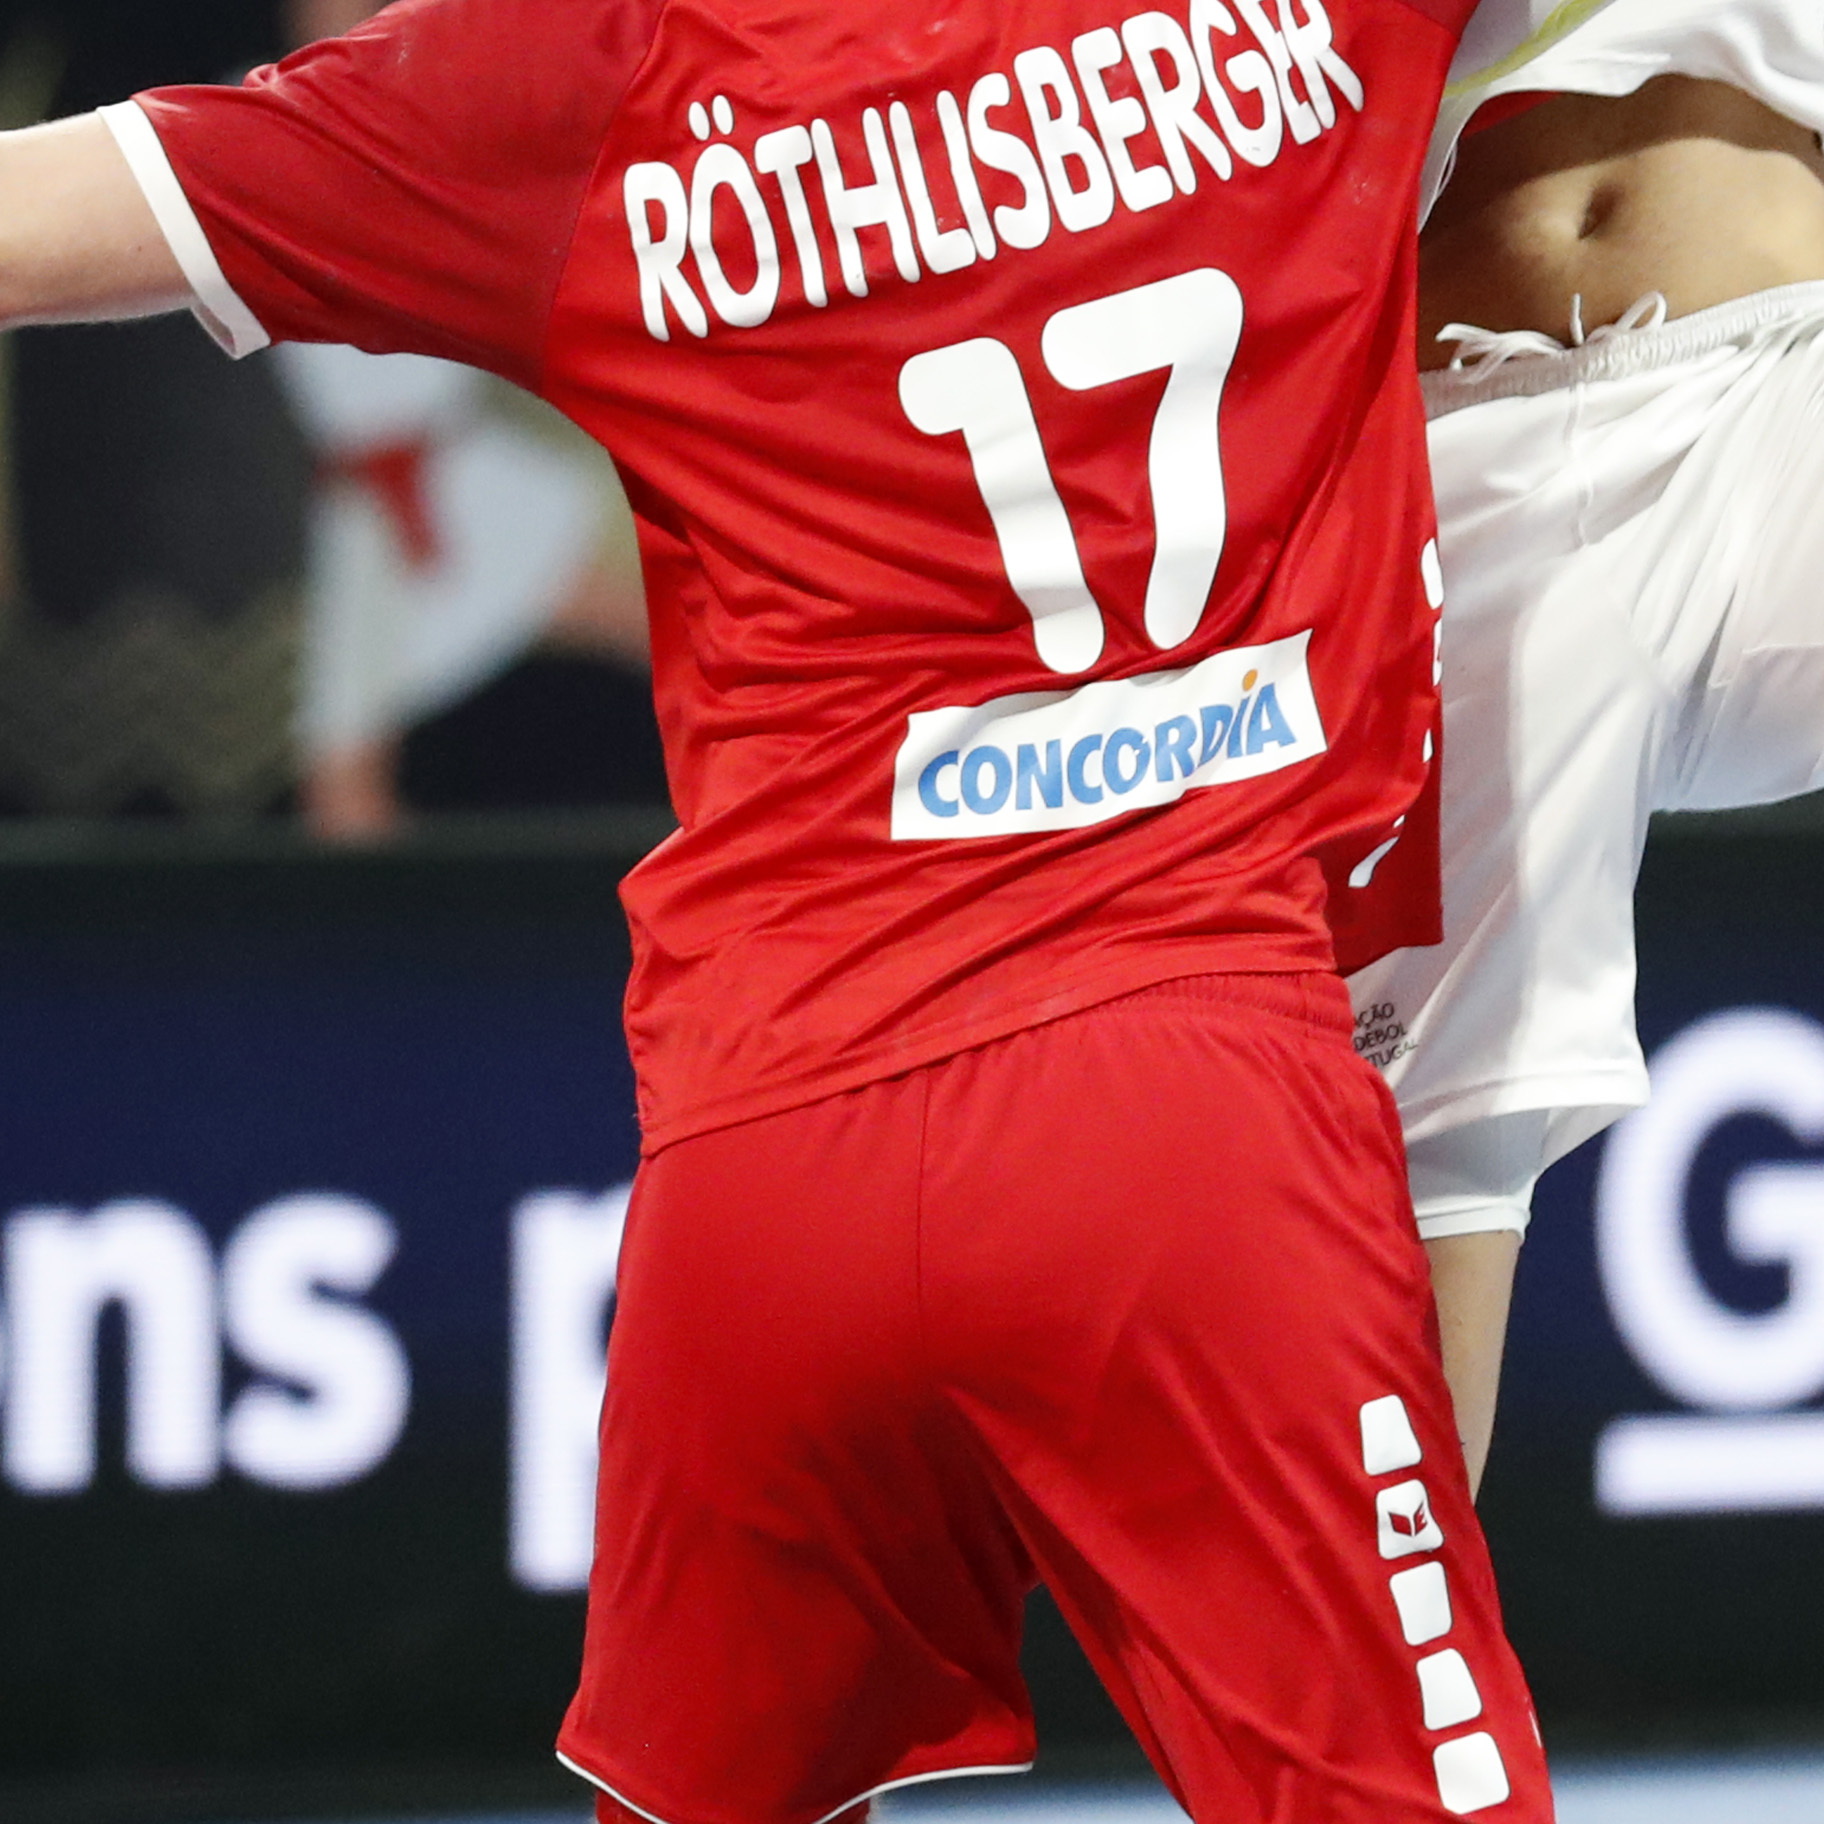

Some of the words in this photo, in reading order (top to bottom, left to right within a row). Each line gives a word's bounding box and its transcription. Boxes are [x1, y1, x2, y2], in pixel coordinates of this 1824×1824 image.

[898, 266, 1244, 675] 17
[917, 667, 1297, 817] CONCORDIA
[1353, 1020, 1408, 1052] DEBOL
[1365, 1039, 1419, 1069] TUGAL
